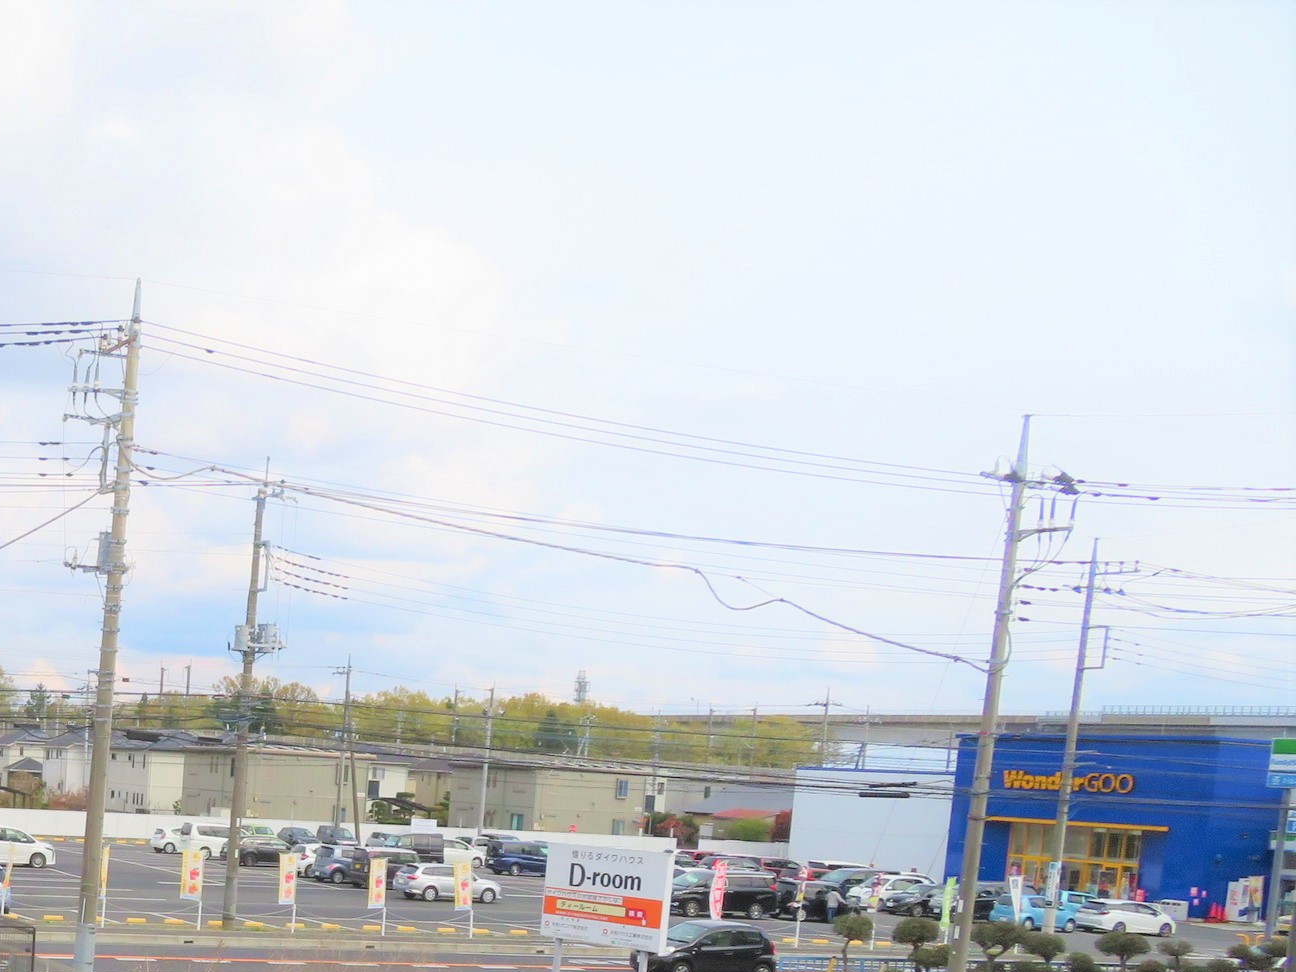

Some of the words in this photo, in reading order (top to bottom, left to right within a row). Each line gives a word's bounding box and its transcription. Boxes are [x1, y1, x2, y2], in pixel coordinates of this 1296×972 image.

[1003, 770, 1134, 793] WondrGOO
[571, 850, 644, 865] 借りるダイワハウス
[569, 863, 642, 891] D-room
[560, 901, 598, 912] ティールーム
